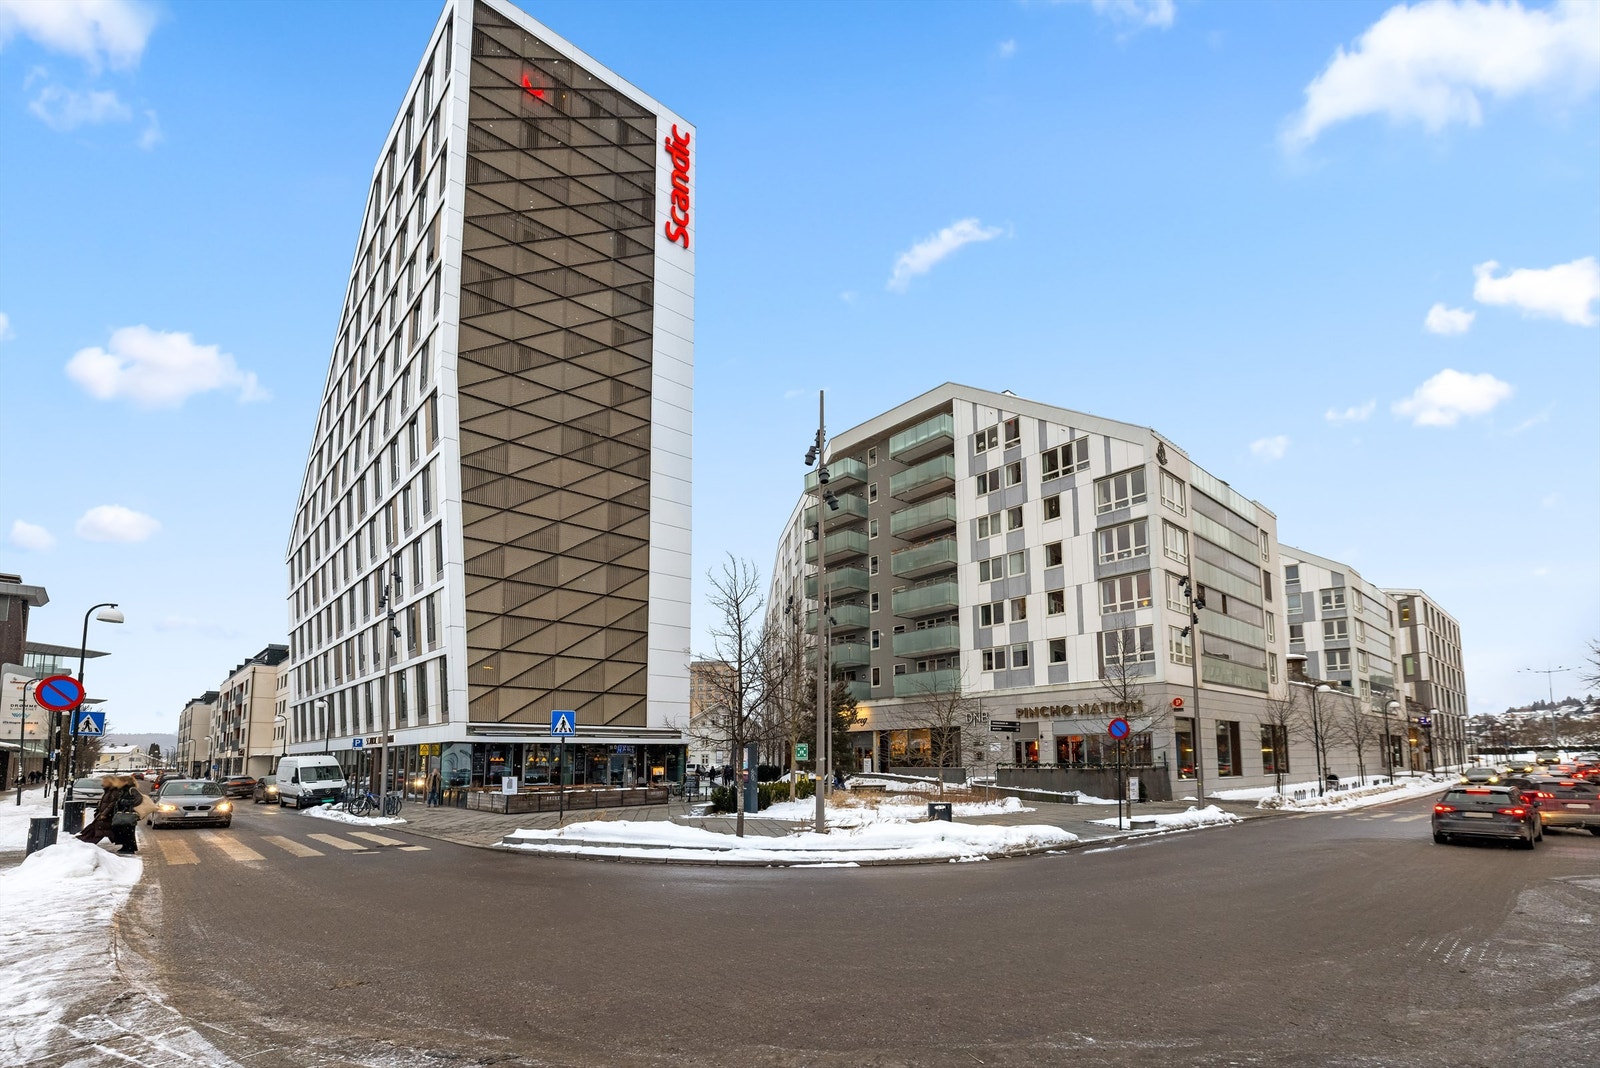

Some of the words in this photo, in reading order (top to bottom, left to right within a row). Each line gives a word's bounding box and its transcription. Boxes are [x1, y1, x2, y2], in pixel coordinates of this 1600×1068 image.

[665, 124, 690, 249] Scandic
[1016, 704, 1074, 719] PINCHO
[1078, 700, 1143, 716] NATION
[965, 712, 988, 727] DNB
